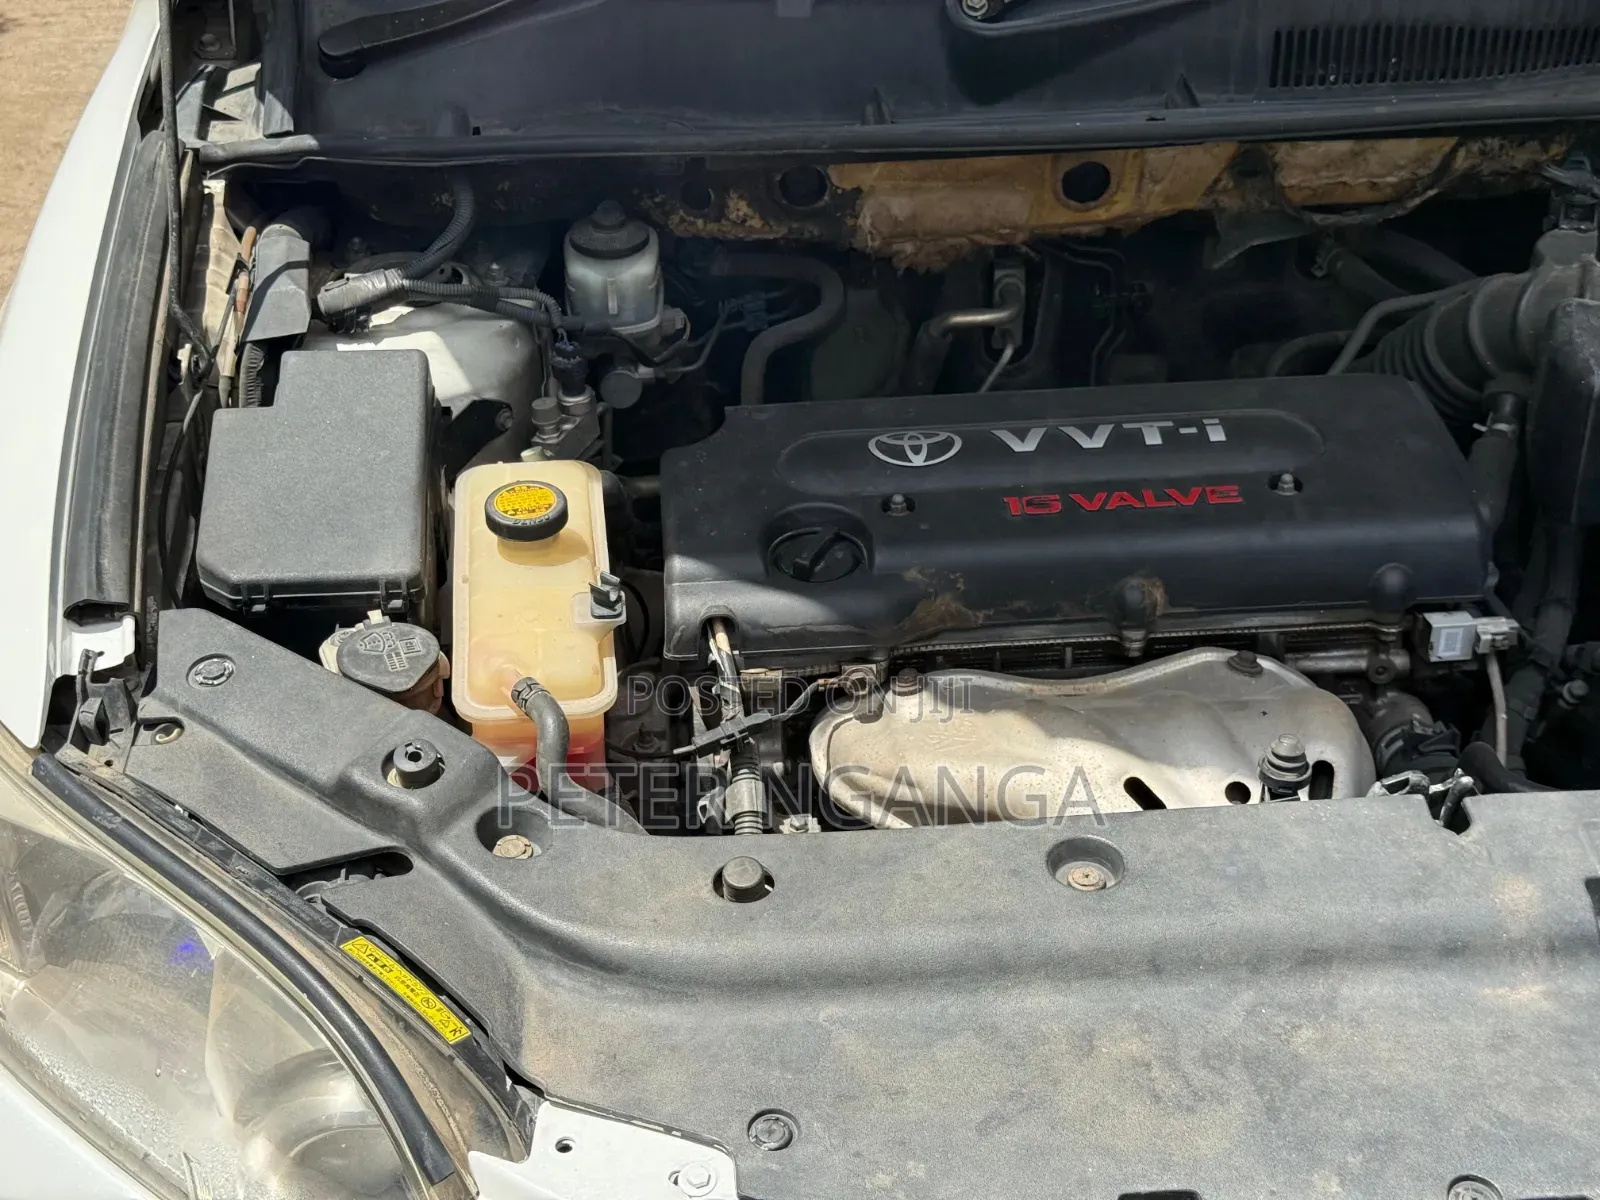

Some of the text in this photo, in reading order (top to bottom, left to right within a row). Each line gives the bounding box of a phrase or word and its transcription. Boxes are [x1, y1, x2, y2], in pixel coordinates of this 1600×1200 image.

[991, 418, 1227, 452] VVT-i
[1004, 485, 1243, 516] 16 VALVE
